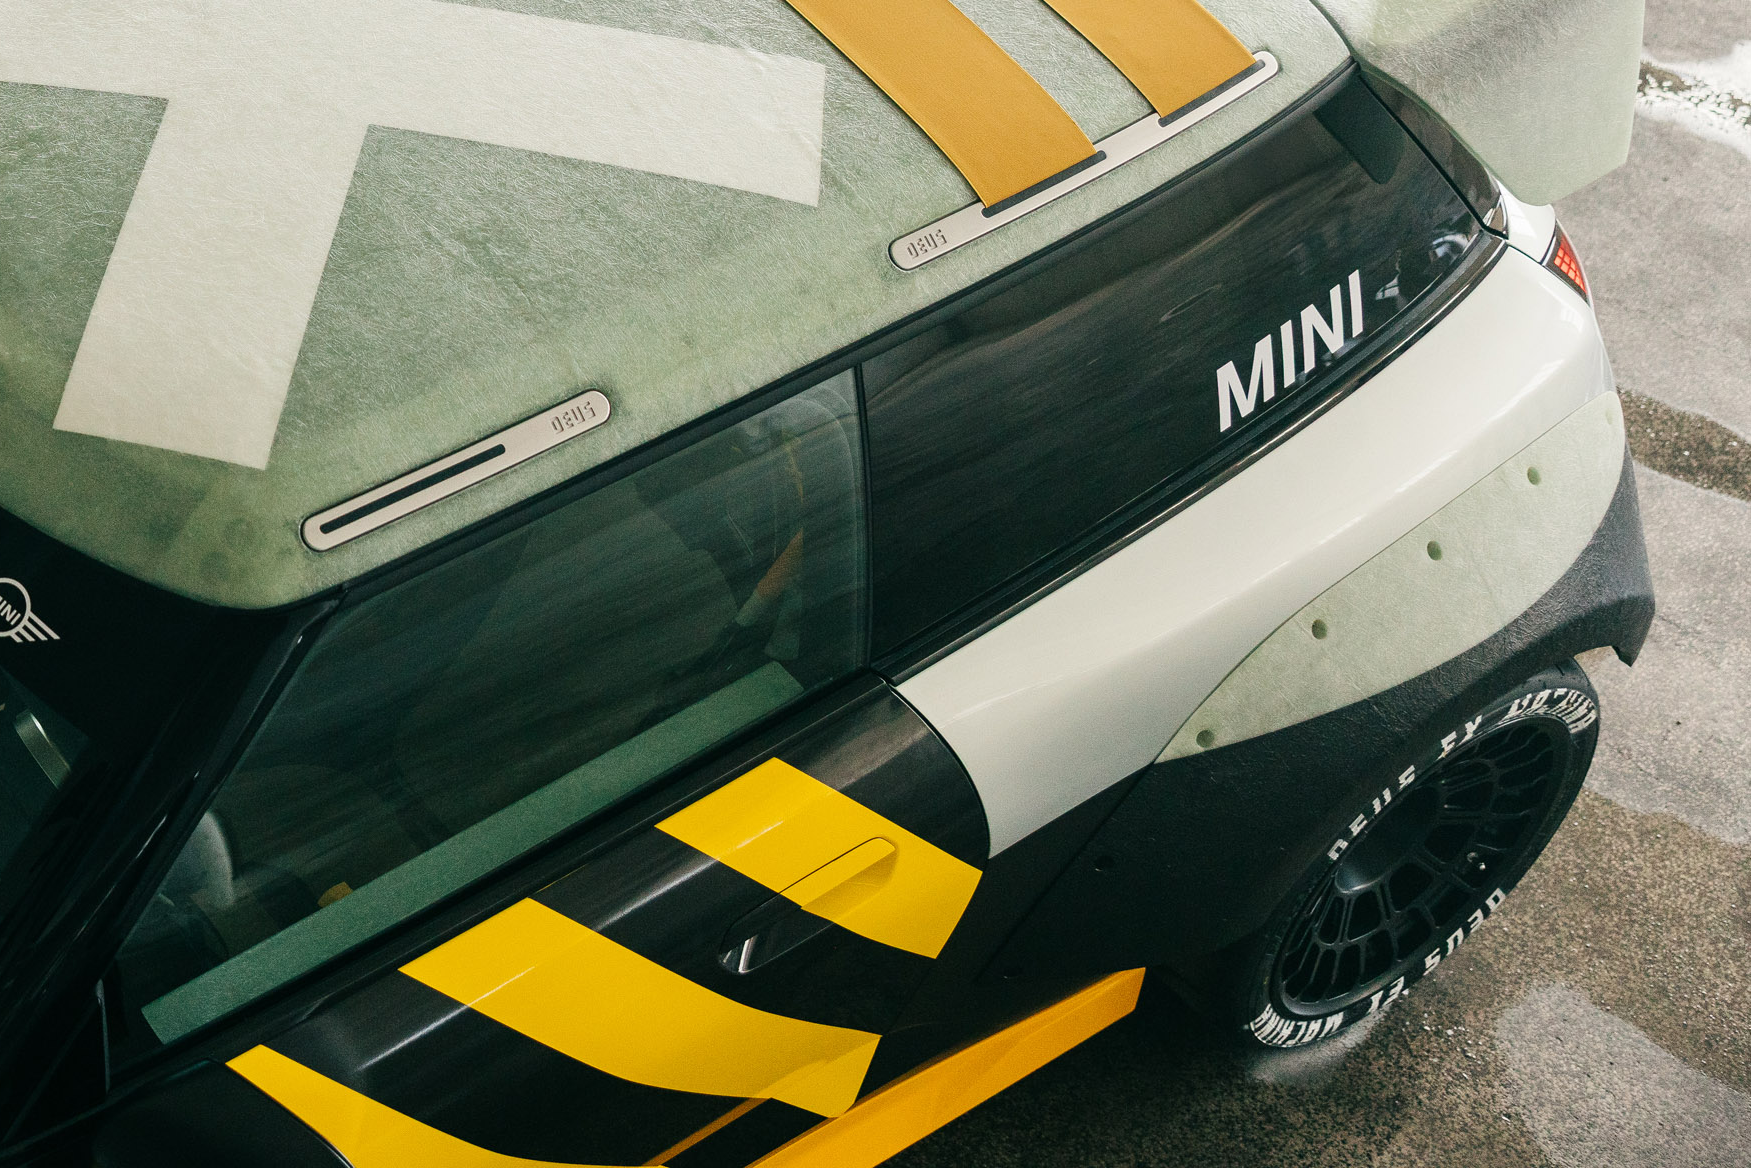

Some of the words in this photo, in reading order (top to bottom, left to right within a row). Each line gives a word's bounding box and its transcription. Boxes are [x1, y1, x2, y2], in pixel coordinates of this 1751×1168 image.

[907, 229, 948, 259] DEUS
[1216, 269, 1364, 432] MINI
[550, 401, 596, 434] DEUS
[1424, 887, 1506, 976] DEUS
